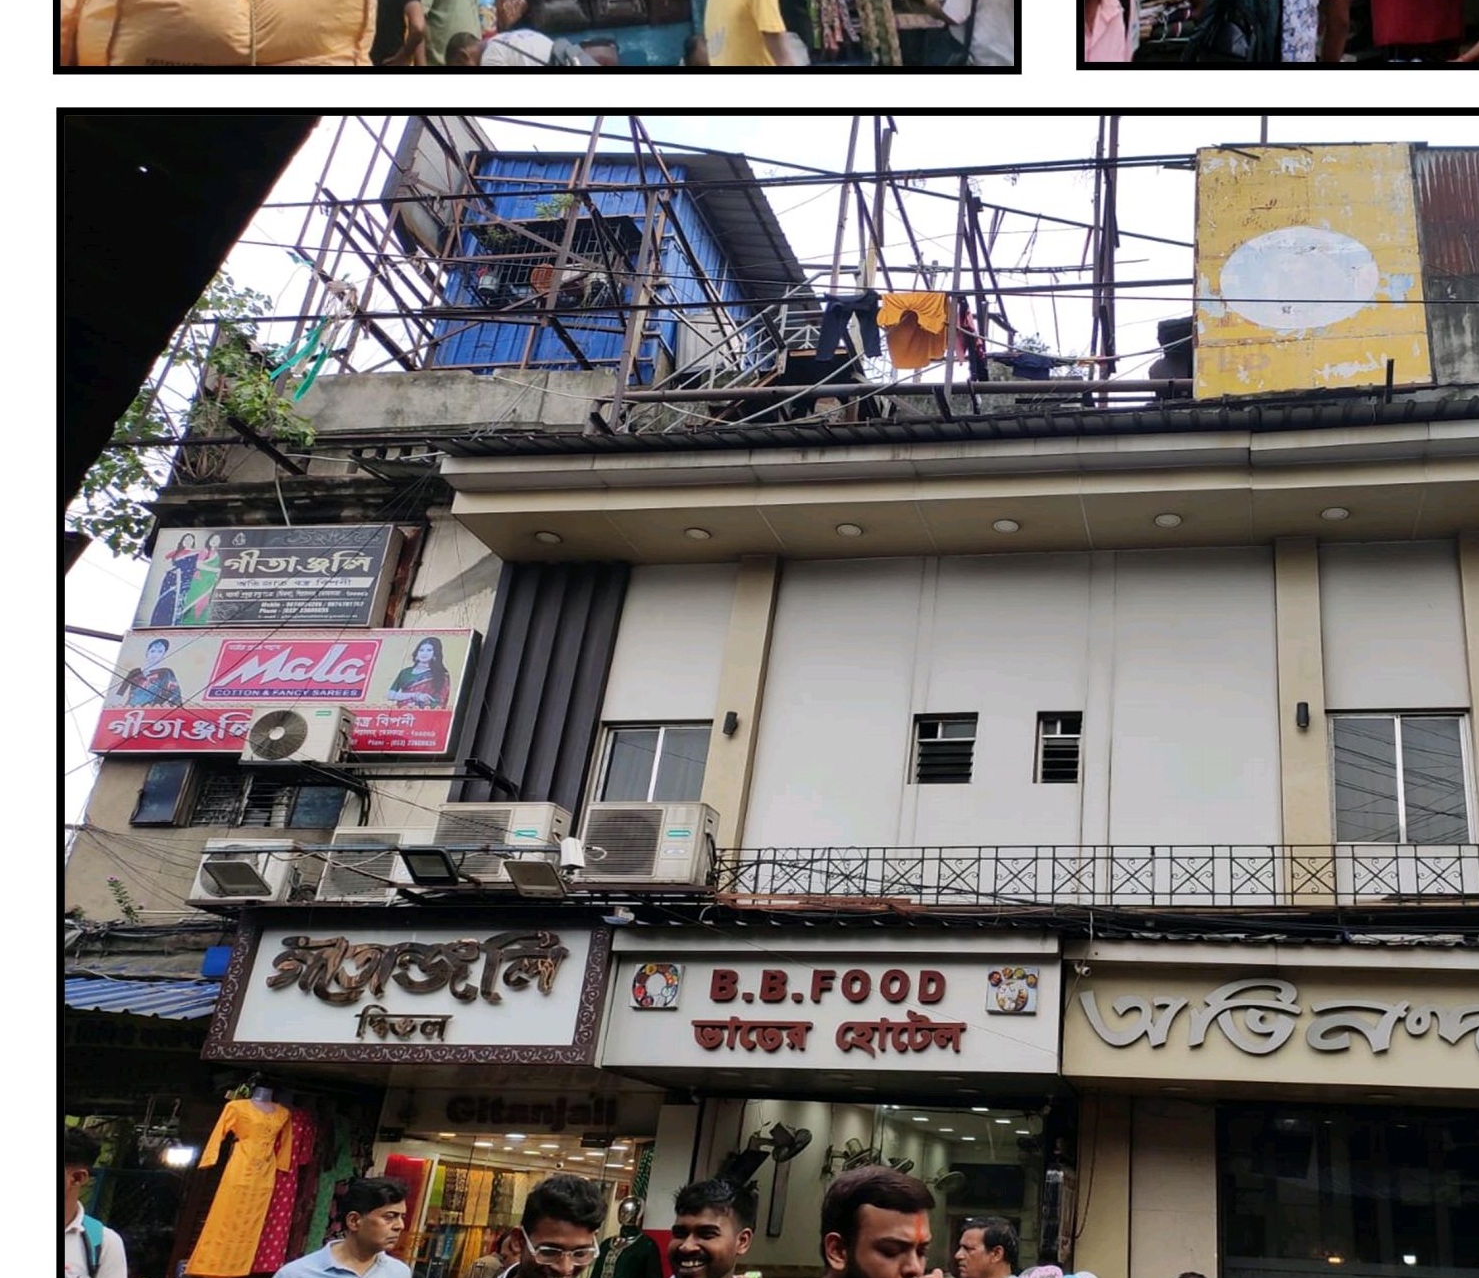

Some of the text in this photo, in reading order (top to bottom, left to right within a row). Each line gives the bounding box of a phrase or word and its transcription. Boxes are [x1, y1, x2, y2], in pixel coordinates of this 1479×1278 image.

[224, 549, 374, 575] গীতাঞ্জলি
[211, 643, 367, 687] Mala
[215, 689, 358, 697] COTTON & FANCY SAREES
[692, 1010, 966, 1058] ভাতের হোটেল
[445, 1092, 618, 1129] Gitanjali
